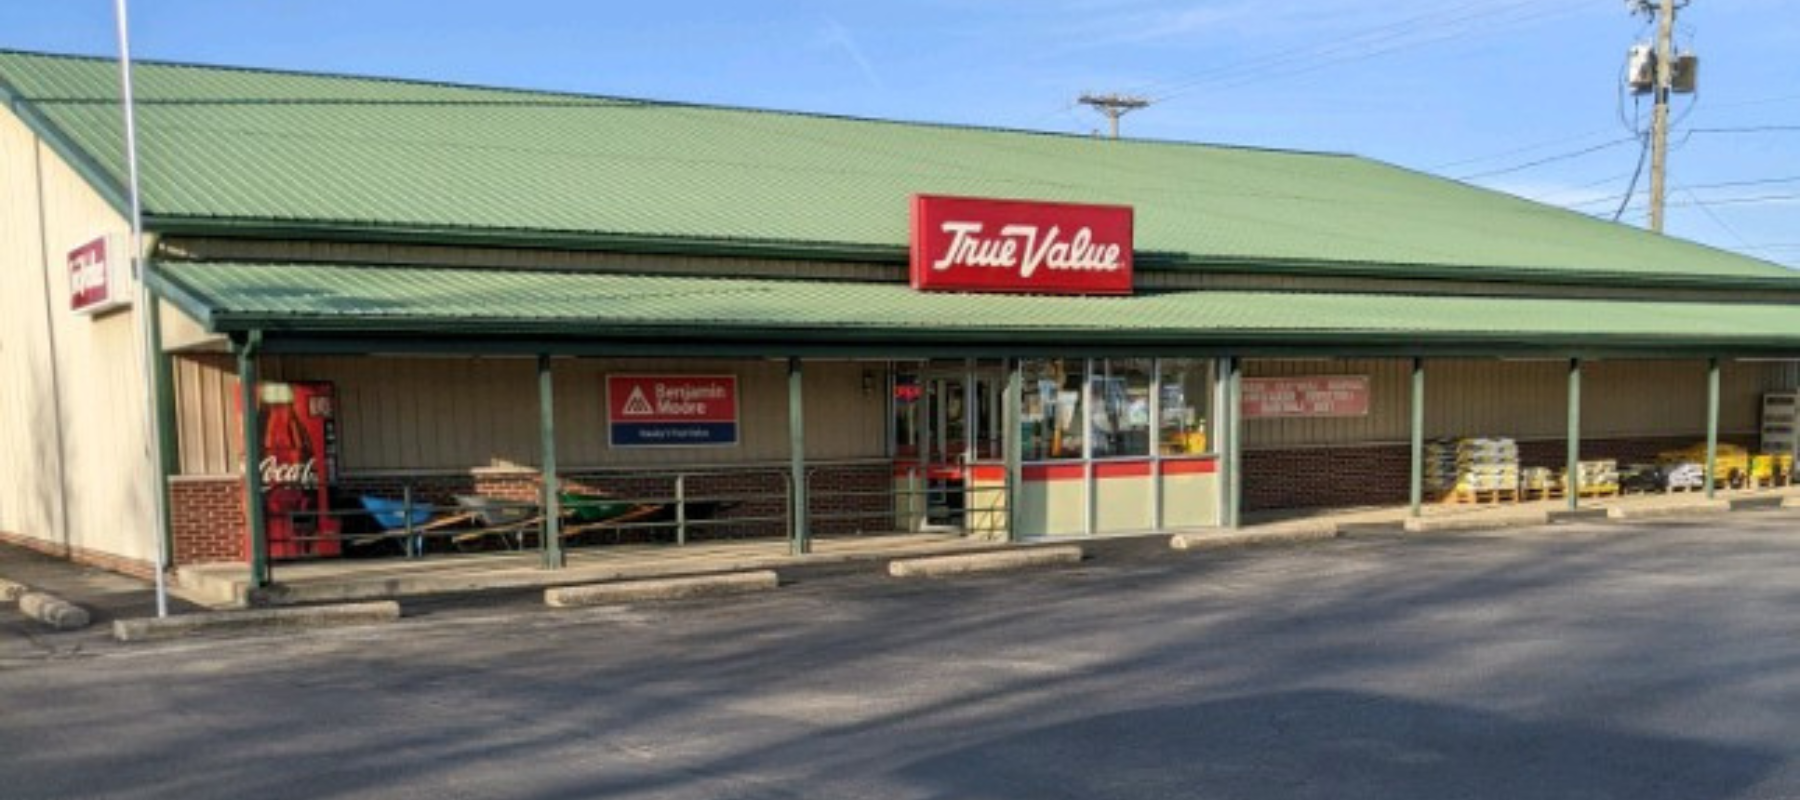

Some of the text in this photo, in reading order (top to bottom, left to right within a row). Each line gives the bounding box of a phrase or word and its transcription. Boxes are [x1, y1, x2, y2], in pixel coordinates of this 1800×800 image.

[933, 221, 1121, 278] True Value
[655, 382, 726, 401] Benjamin
[656, 400, 707, 415] Moore
